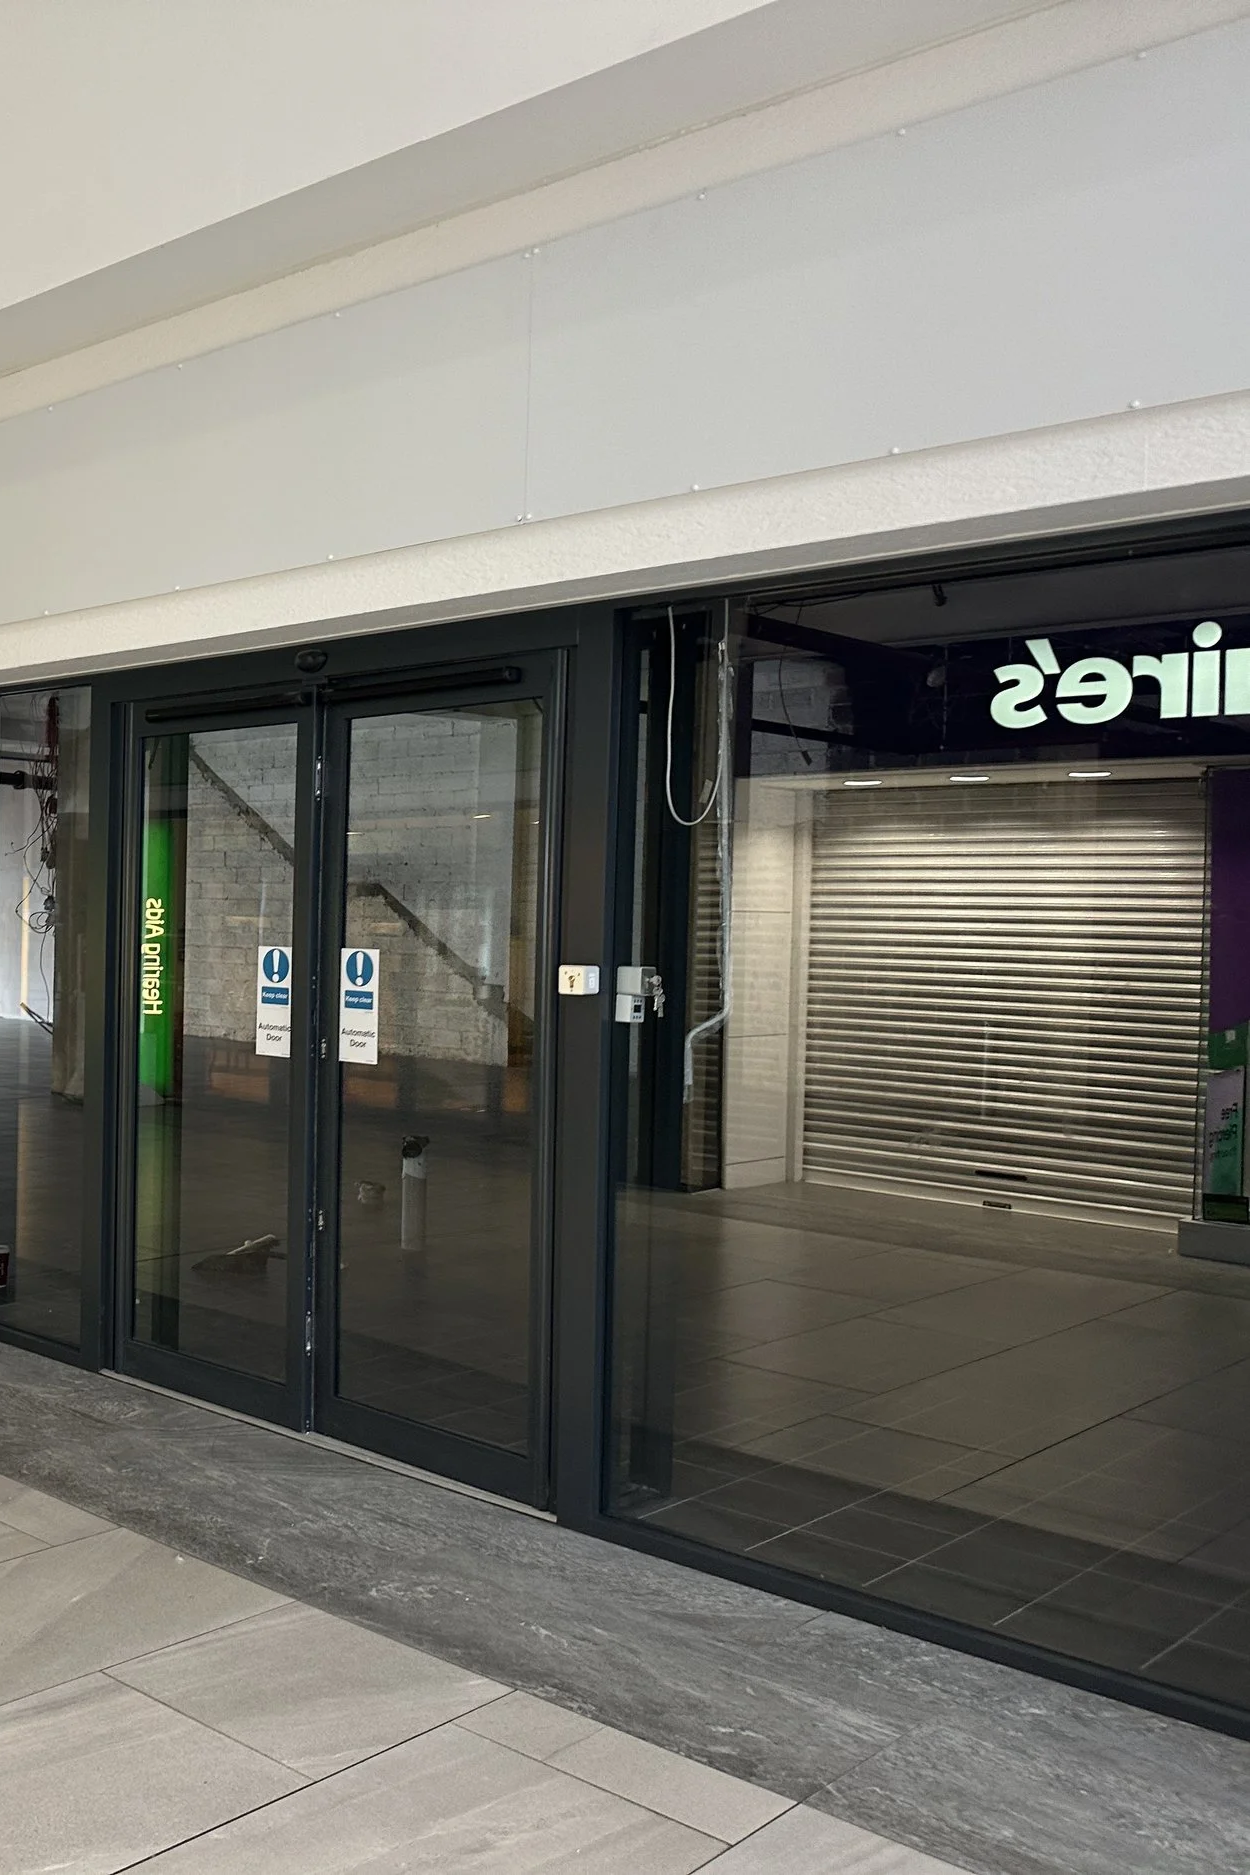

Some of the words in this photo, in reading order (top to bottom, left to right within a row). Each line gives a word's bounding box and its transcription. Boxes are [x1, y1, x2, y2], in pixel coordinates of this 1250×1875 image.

[258, 1022, 291, 1032] Automatic
[266, 1033, 282, 1041] Door
[341, 1027, 376, 1038] Automatic
[350, 1039, 366, 1048] Door
